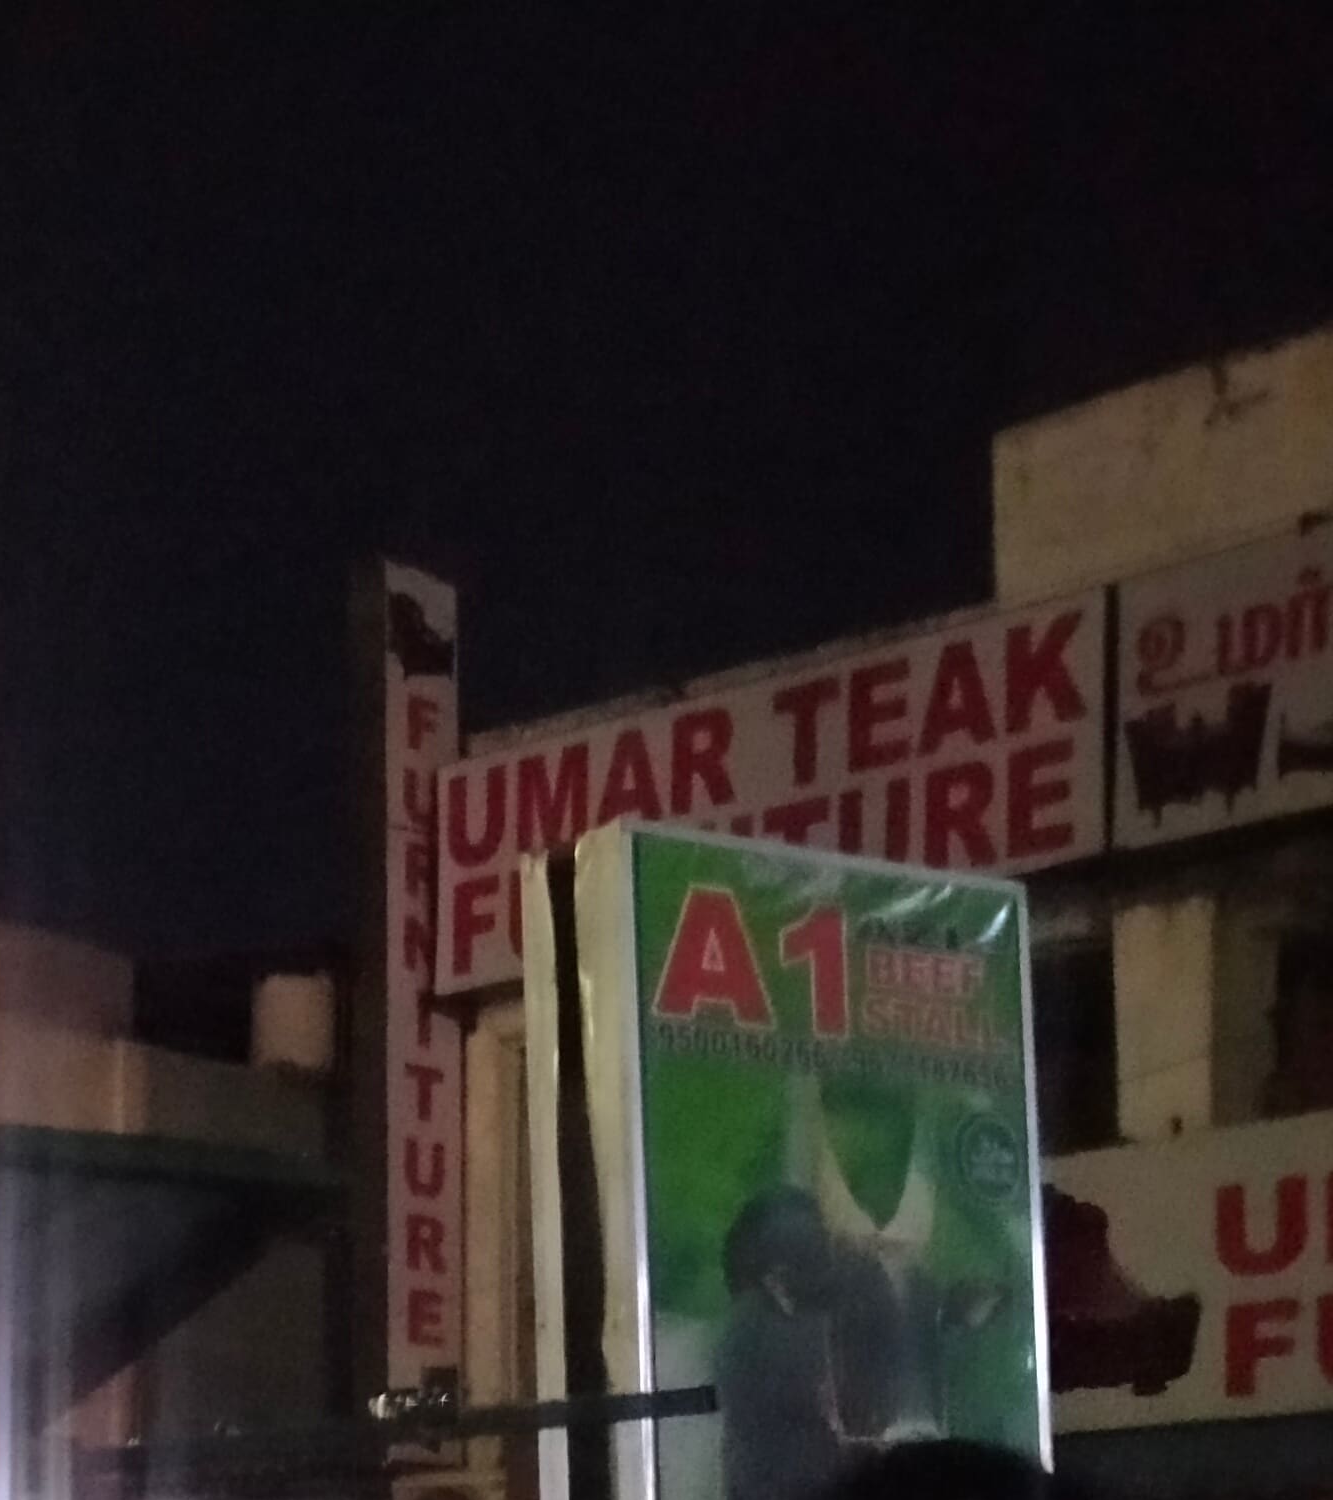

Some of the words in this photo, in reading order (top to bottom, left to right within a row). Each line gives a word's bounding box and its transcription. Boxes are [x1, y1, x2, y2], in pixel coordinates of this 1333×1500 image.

[448, 707, 737, 867] UMAR
[772, 609, 1087, 786] TEAK
[651, 881, 851, 1041] A1
